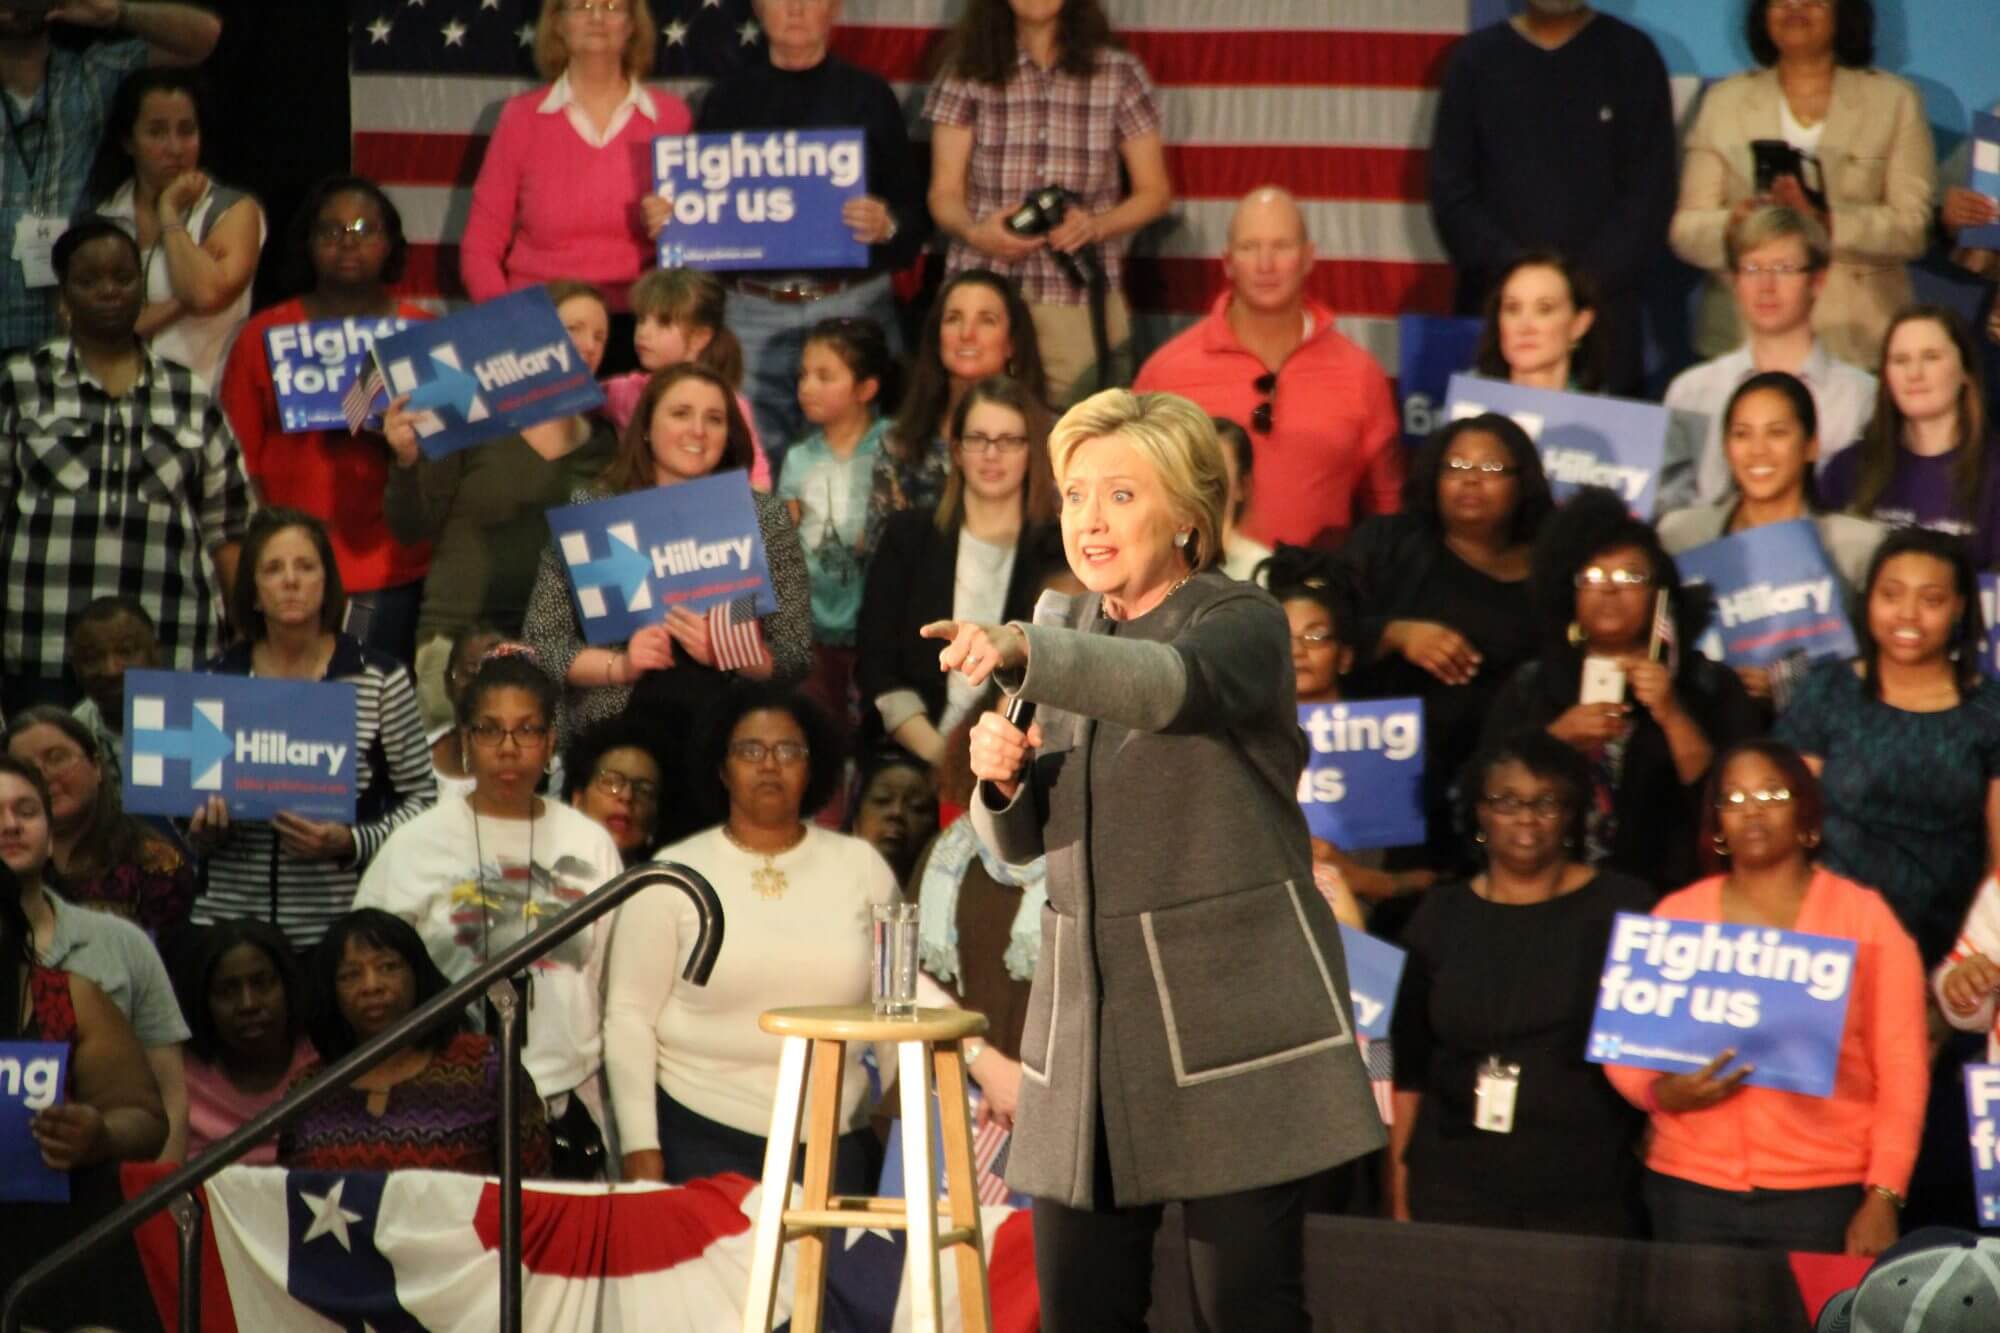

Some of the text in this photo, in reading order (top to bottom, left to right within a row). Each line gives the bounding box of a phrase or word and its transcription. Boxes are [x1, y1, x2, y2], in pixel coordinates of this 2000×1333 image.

[655, 131, 861, 189] Fighting
[736, 187, 795, 223] us
[273, 364, 346, 396] for
[474, 341, 571, 392] Hillary
[651, 538, 752, 578] Hillary
[1717, 577, 1832, 627] Hillary
[235, 730, 348, 776] Hillary
[1611, 915, 1851, 1001] Fighting
[1600, 963, 1761, 1029] for us
